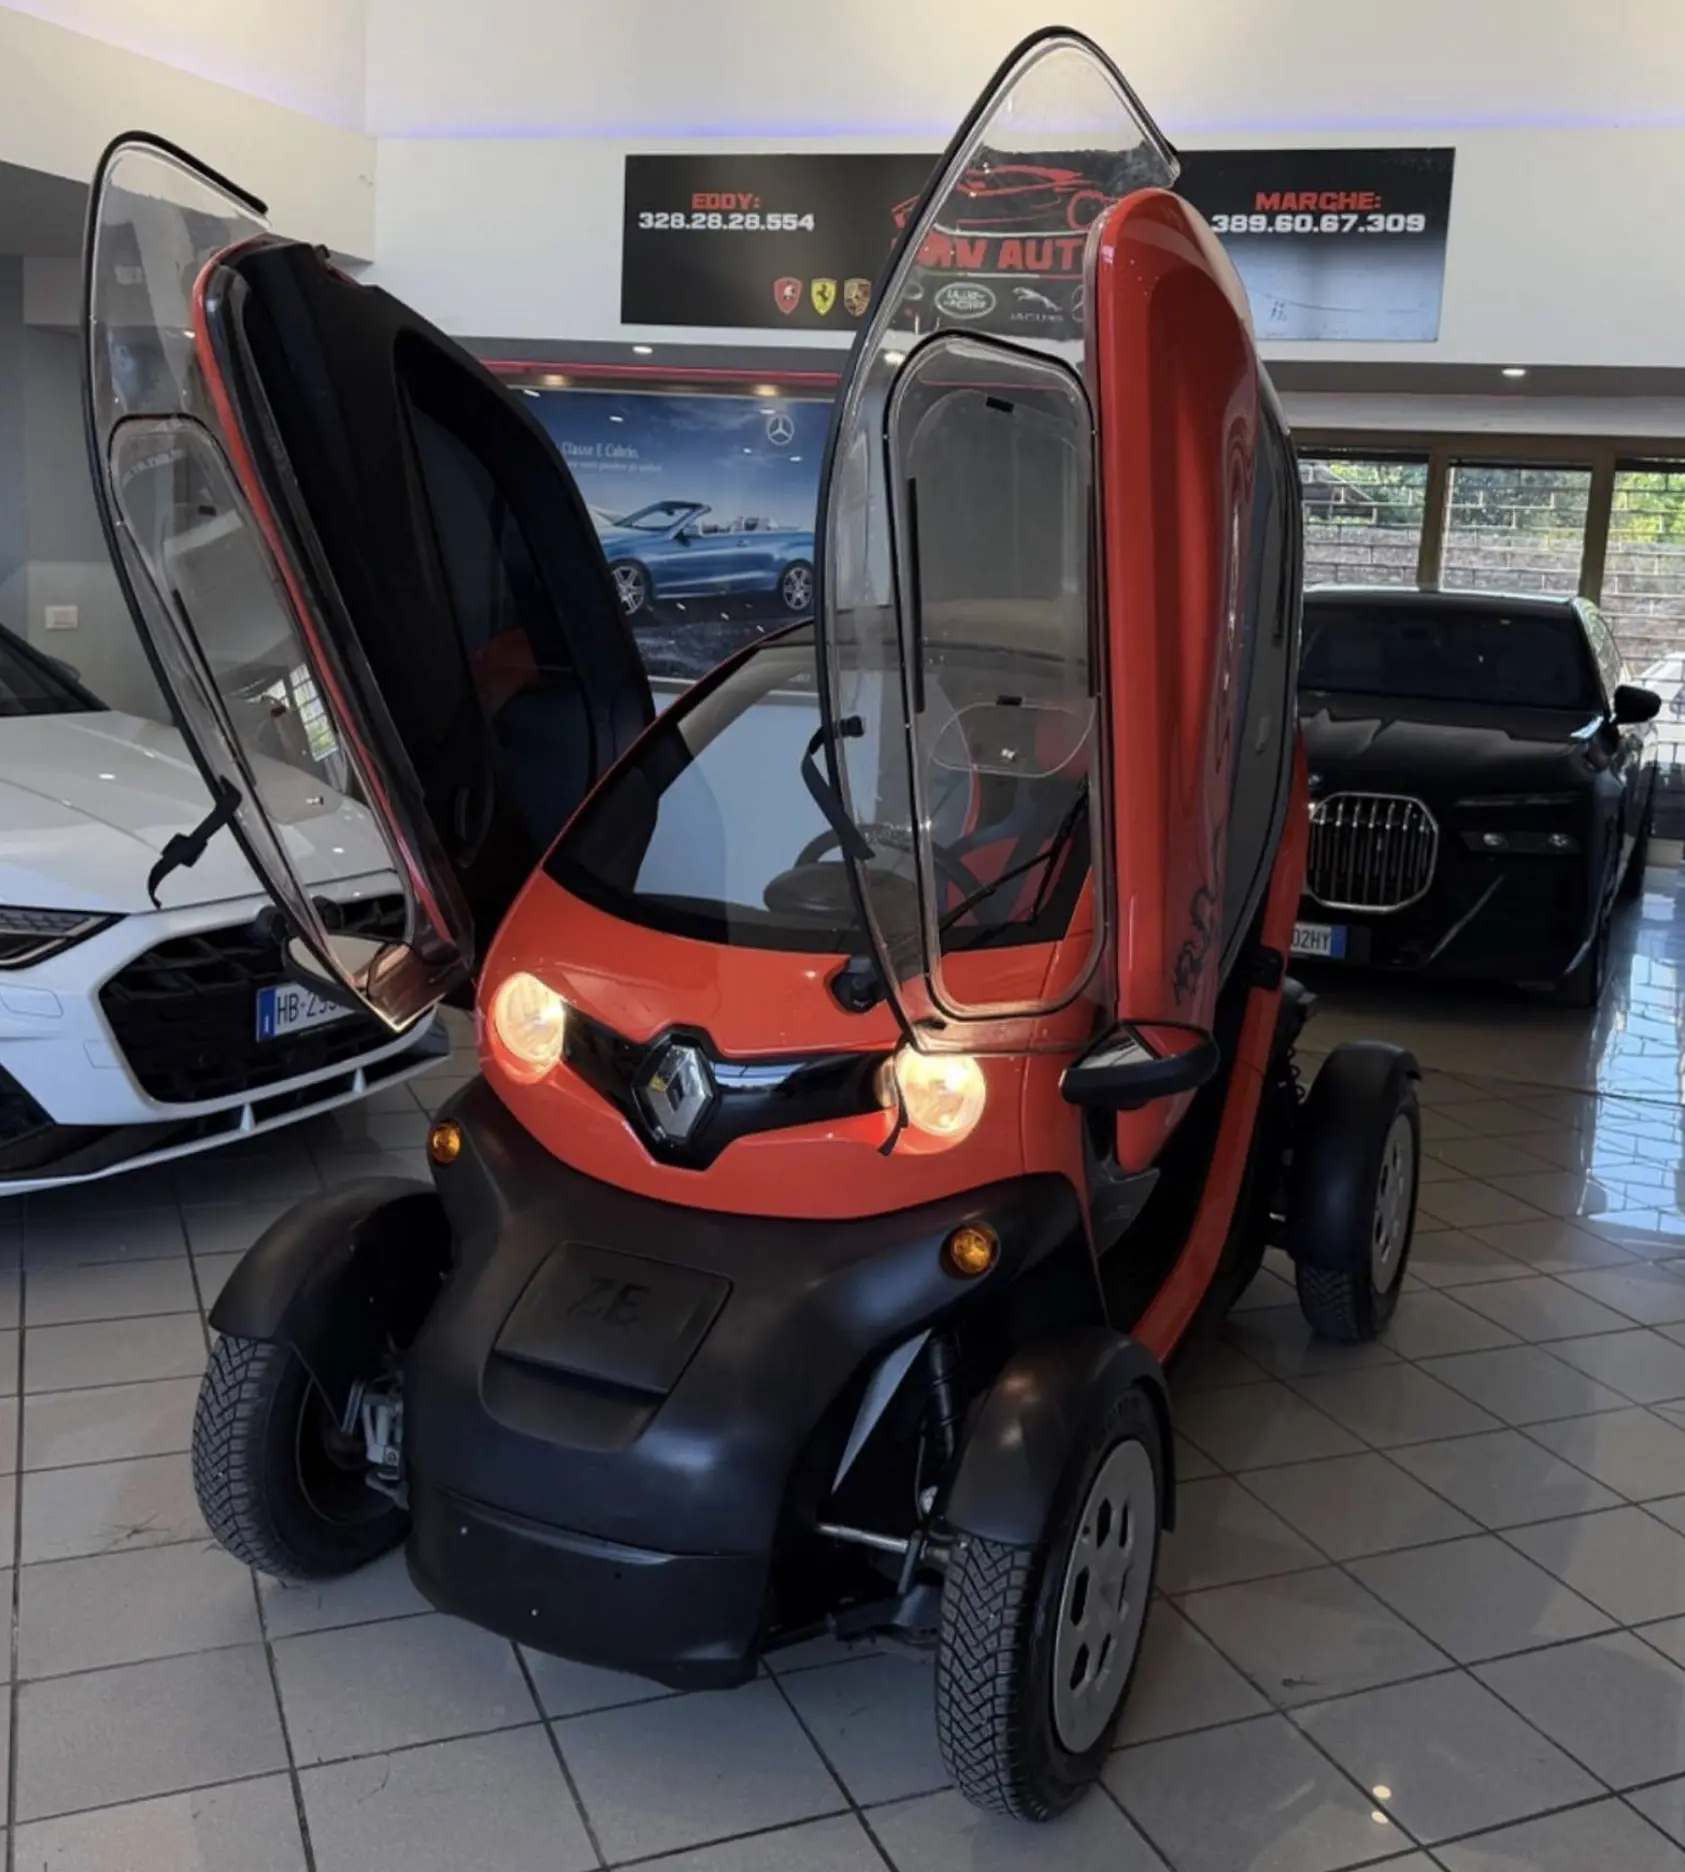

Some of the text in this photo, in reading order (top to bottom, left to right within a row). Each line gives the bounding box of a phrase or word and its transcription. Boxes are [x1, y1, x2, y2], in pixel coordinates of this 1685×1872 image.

[691, 193, 760, 210] EDDY:
[1255, 192, 1382, 211] MARCHE:
[638, 212, 815, 232] 328.28.28.554
[1211, 213, 1426, 233] 389.60.67.309
[998, 238, 1084, 270] AUT
